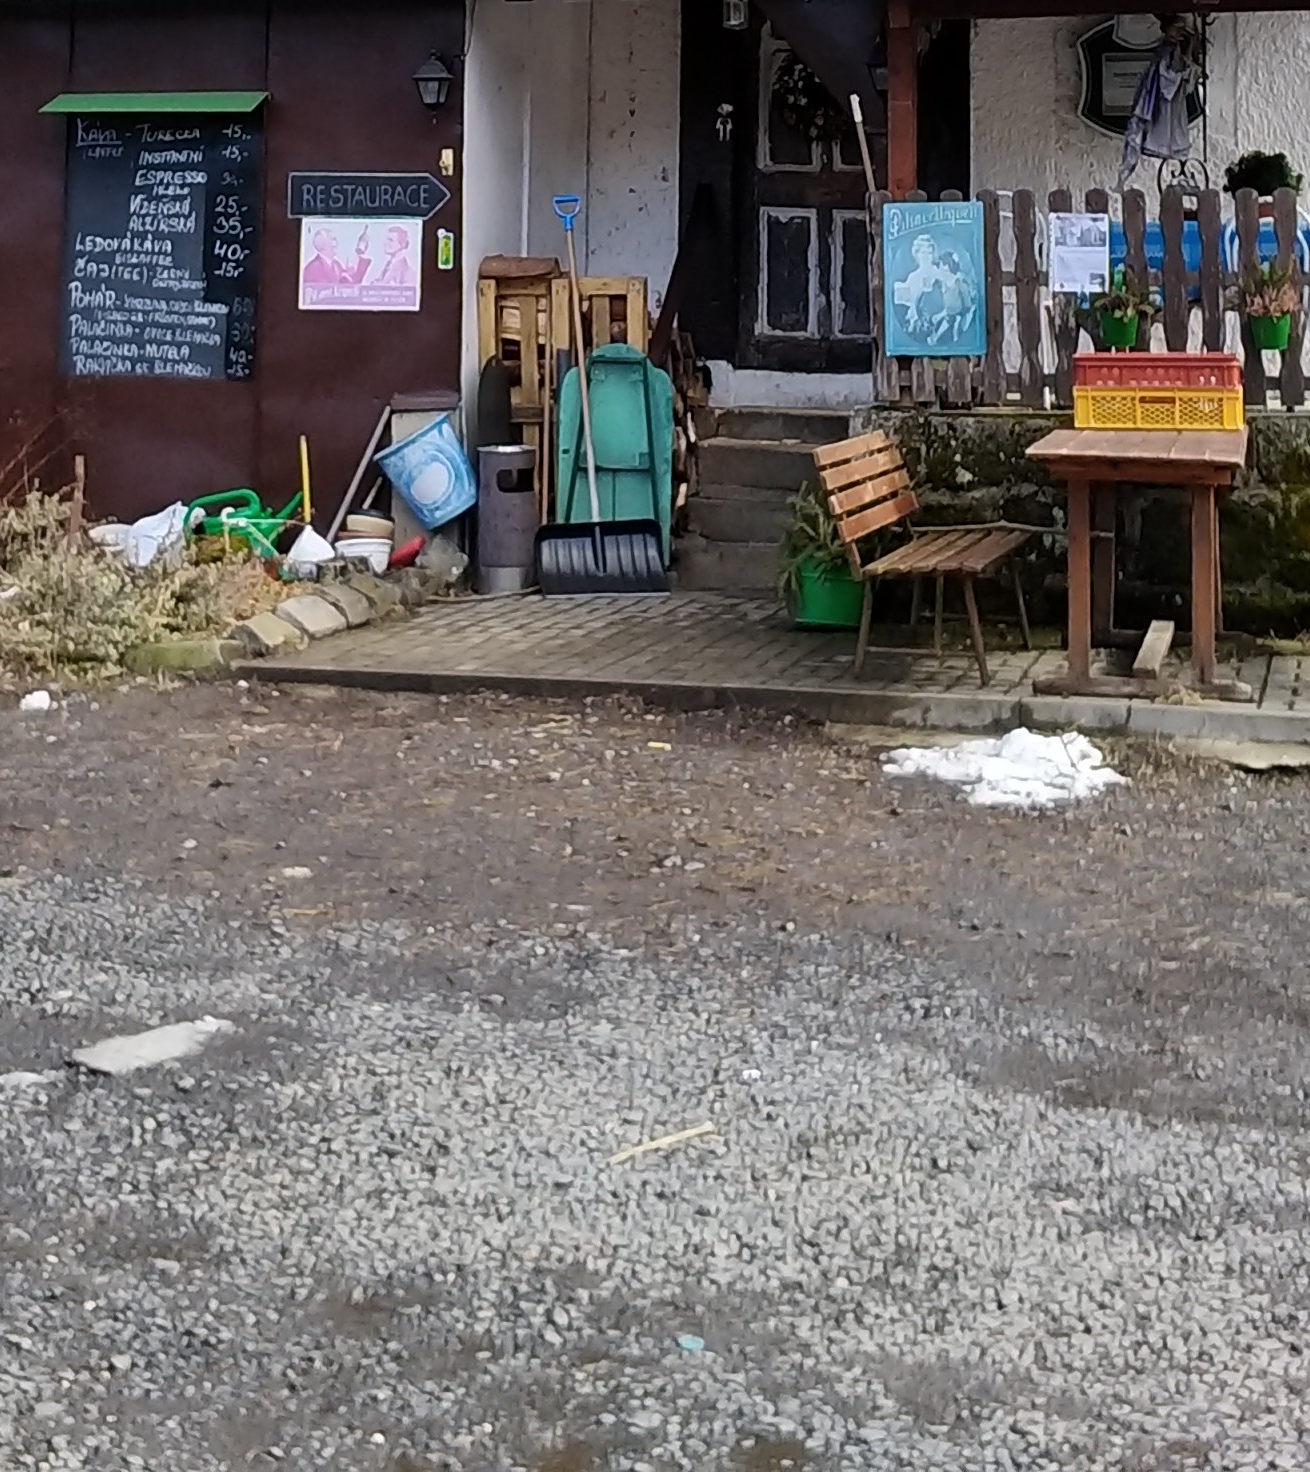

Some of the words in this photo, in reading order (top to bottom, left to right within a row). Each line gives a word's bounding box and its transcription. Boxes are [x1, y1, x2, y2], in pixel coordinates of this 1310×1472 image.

[134, 169, 208, 186] ESPRESSO
[302, 184, 430, 209] RESTAURACE
[212, 216, 254, 239] 35,-
[75, 231, 132, 253] LEDOVÁ
[133, 233, 173, 253] KÁVA
